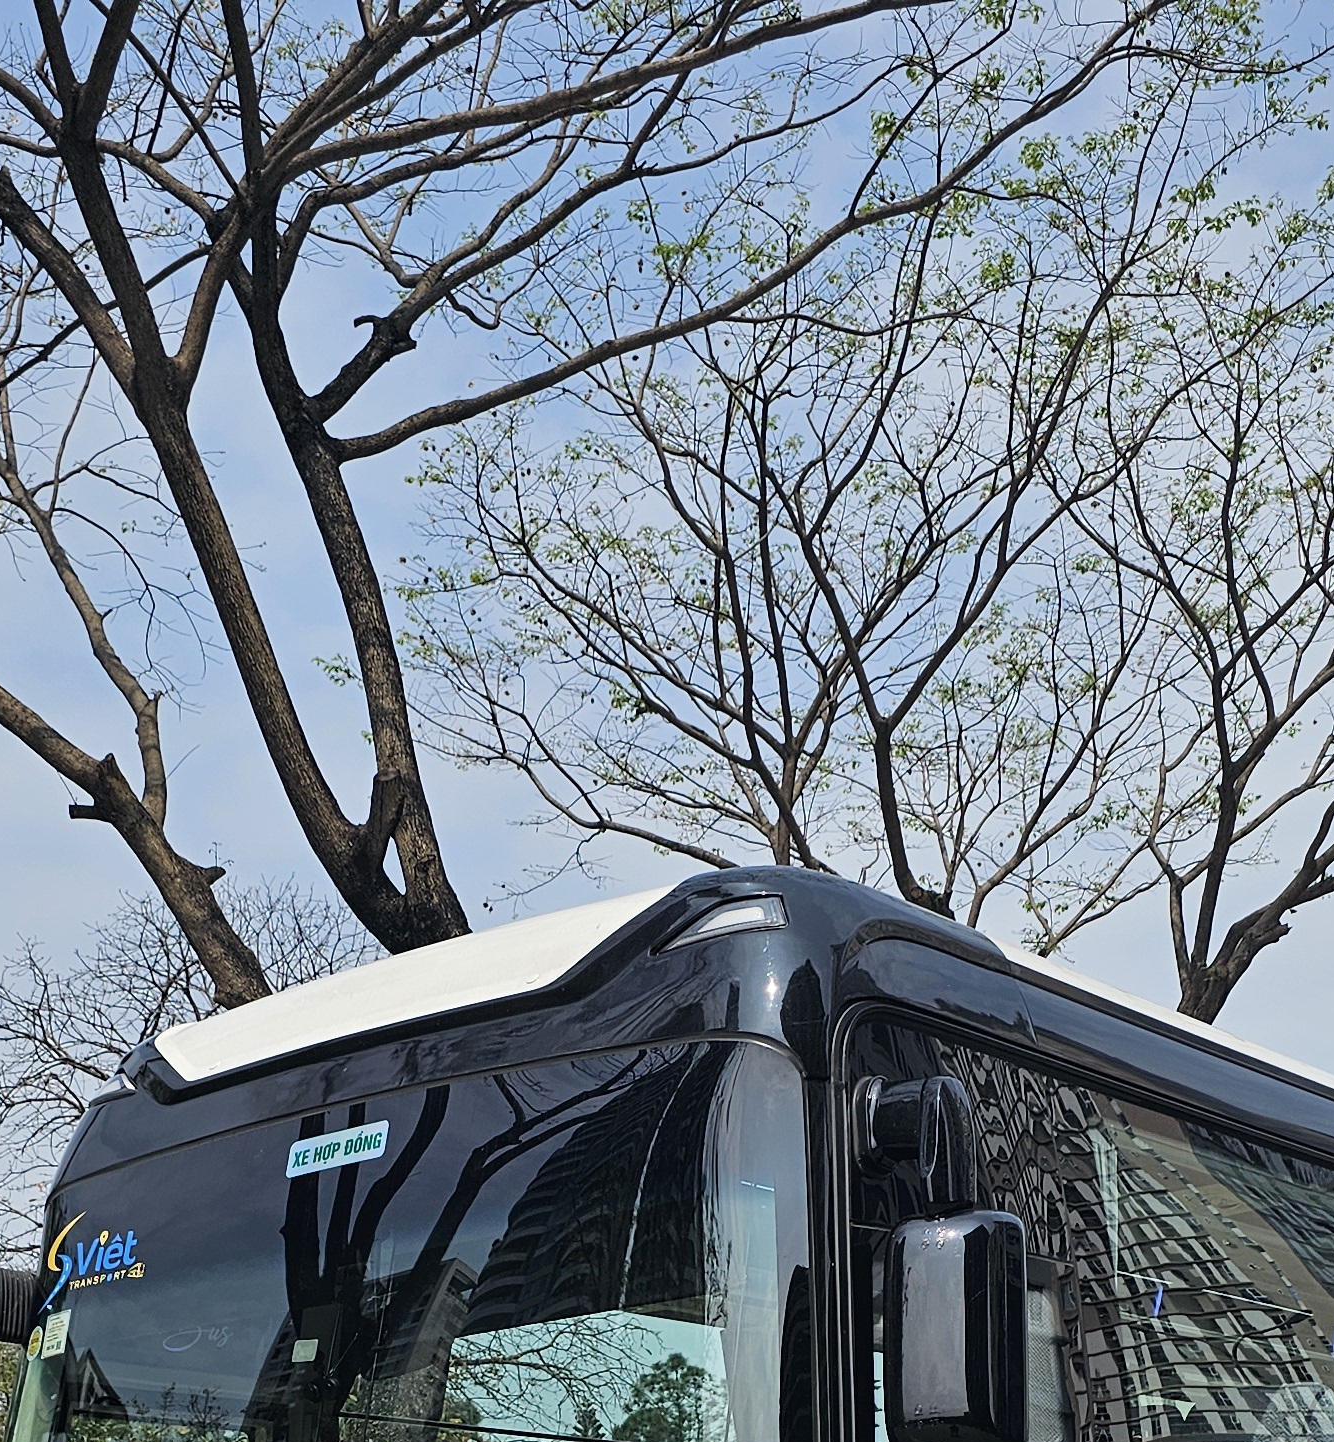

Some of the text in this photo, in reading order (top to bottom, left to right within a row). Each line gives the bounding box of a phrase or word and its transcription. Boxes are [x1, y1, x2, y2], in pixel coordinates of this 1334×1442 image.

[292, 1131, 382, 1168] XE HỢP ĐỒNG
[69, 1269, 127, 1290] TRANSPORT
